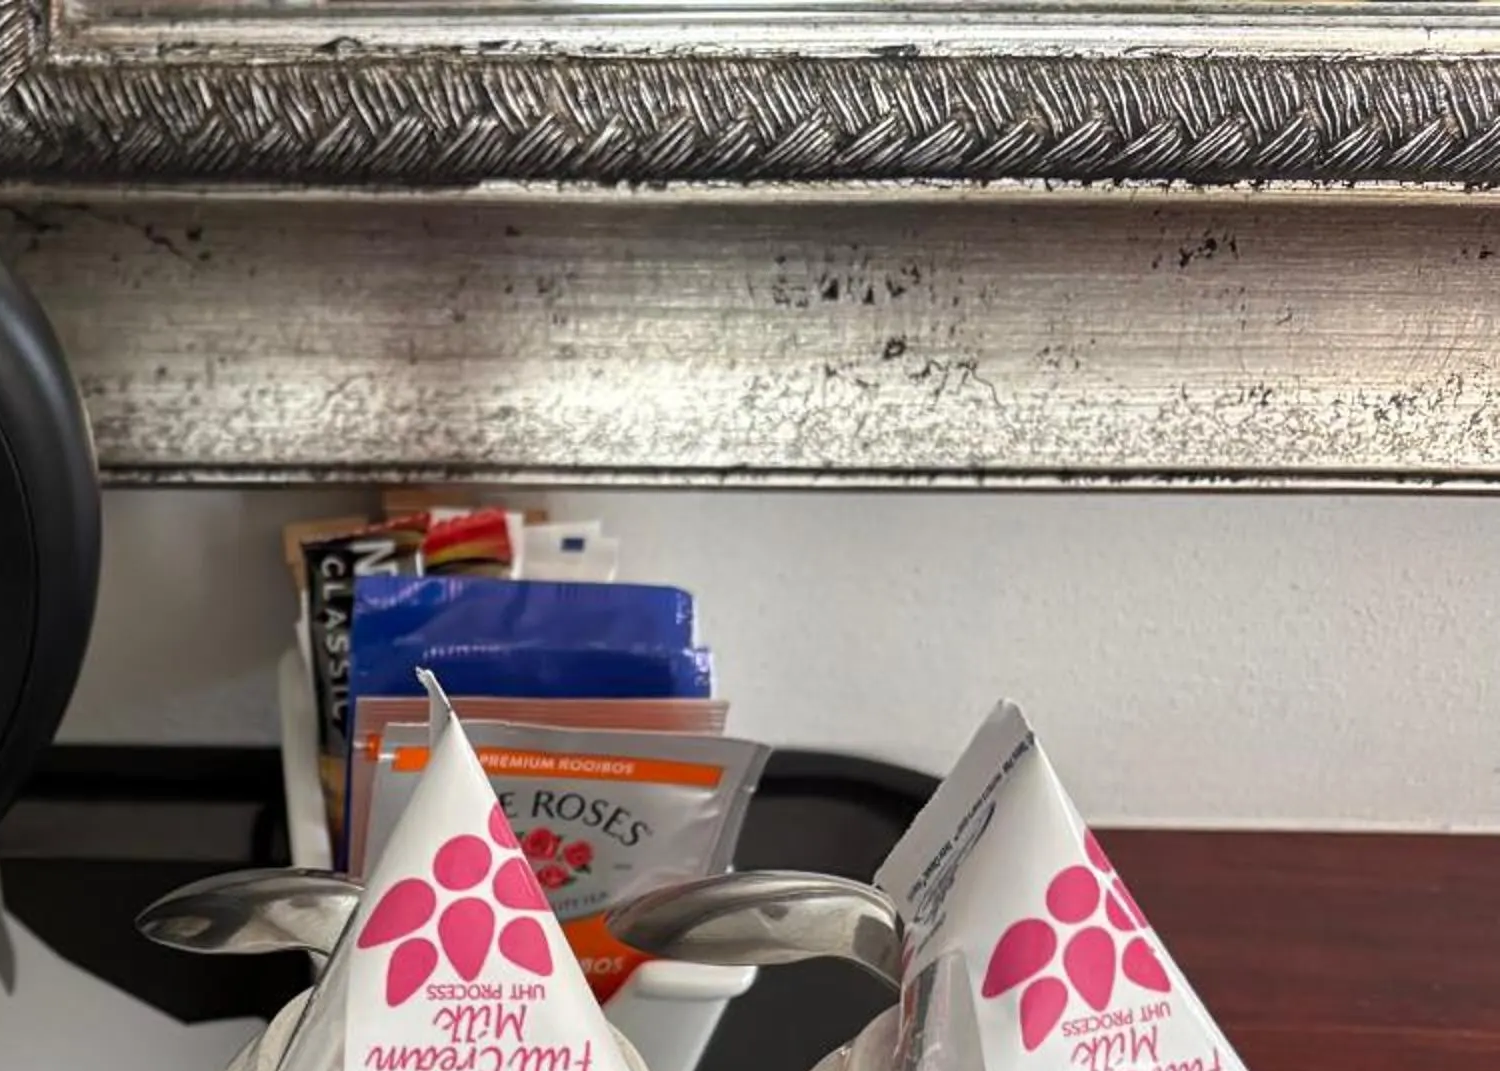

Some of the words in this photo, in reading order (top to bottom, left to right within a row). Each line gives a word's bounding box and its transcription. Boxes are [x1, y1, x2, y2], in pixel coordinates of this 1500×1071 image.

[320, 555, 350, 721] CLASSIC
[480, 752, 554, 770] PREMIUM
[558, 756, 635, 776] ROOIBOS
[530, 788, 648, 847] ROSES
[425, 983, 503, 1000] PROCESS
[508, 982, 546, 999] UHT
[432, 1005, 528, 1043] Milk
[1061, 1009, 1135, 1038] PROCESS
[1137, 1001, 1172, 1023] UHT
